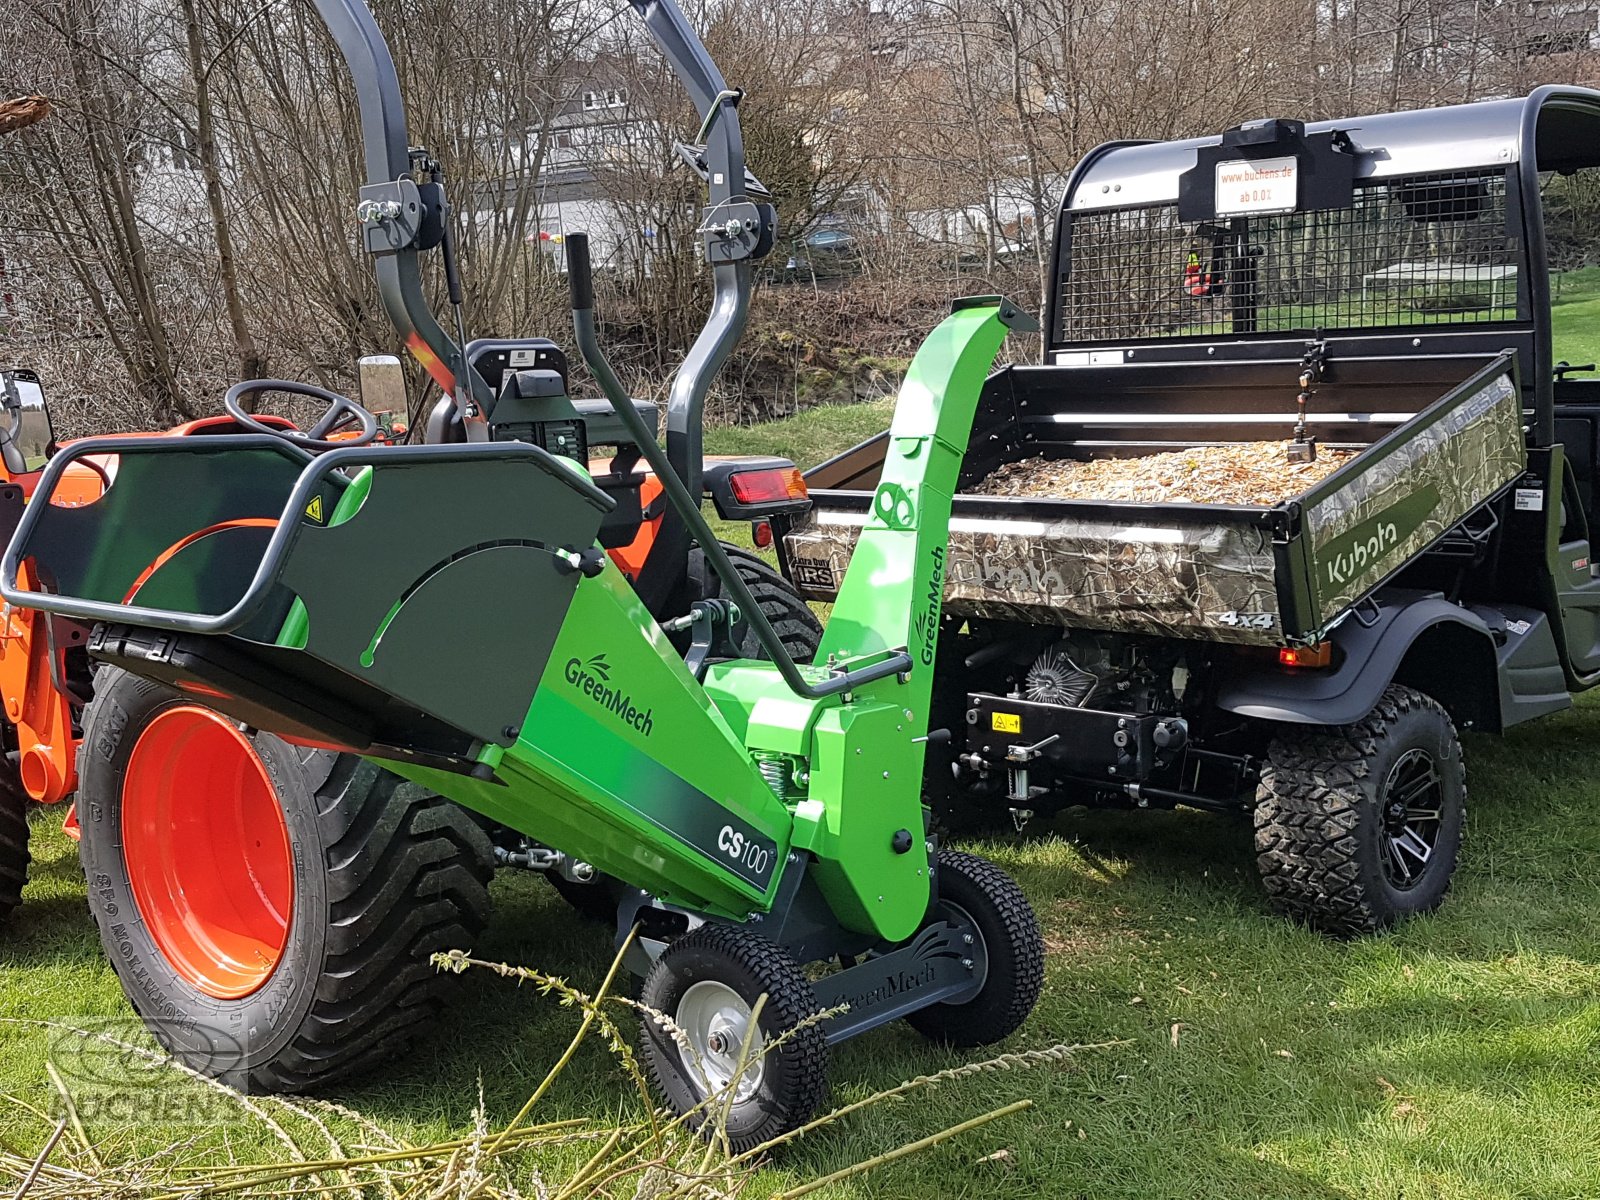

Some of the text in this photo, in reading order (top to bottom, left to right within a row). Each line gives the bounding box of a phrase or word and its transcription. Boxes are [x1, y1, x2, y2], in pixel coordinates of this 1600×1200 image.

[1221, 166, 1292, 183] www.buchens.de
[1239, 191, 1250, 203] ab
[798, 566, 834, 585] IRS
[1327, 522, 1397, 583] Kubota
[921, 546, 944, 667] GreenMech
[1219, 610, 1274, 629] 4x4
[564, 656, 654, 737] GreenMech
[718, 825, 768, 874] CS100
[110, 922, 198, 1037] FLOTATION
